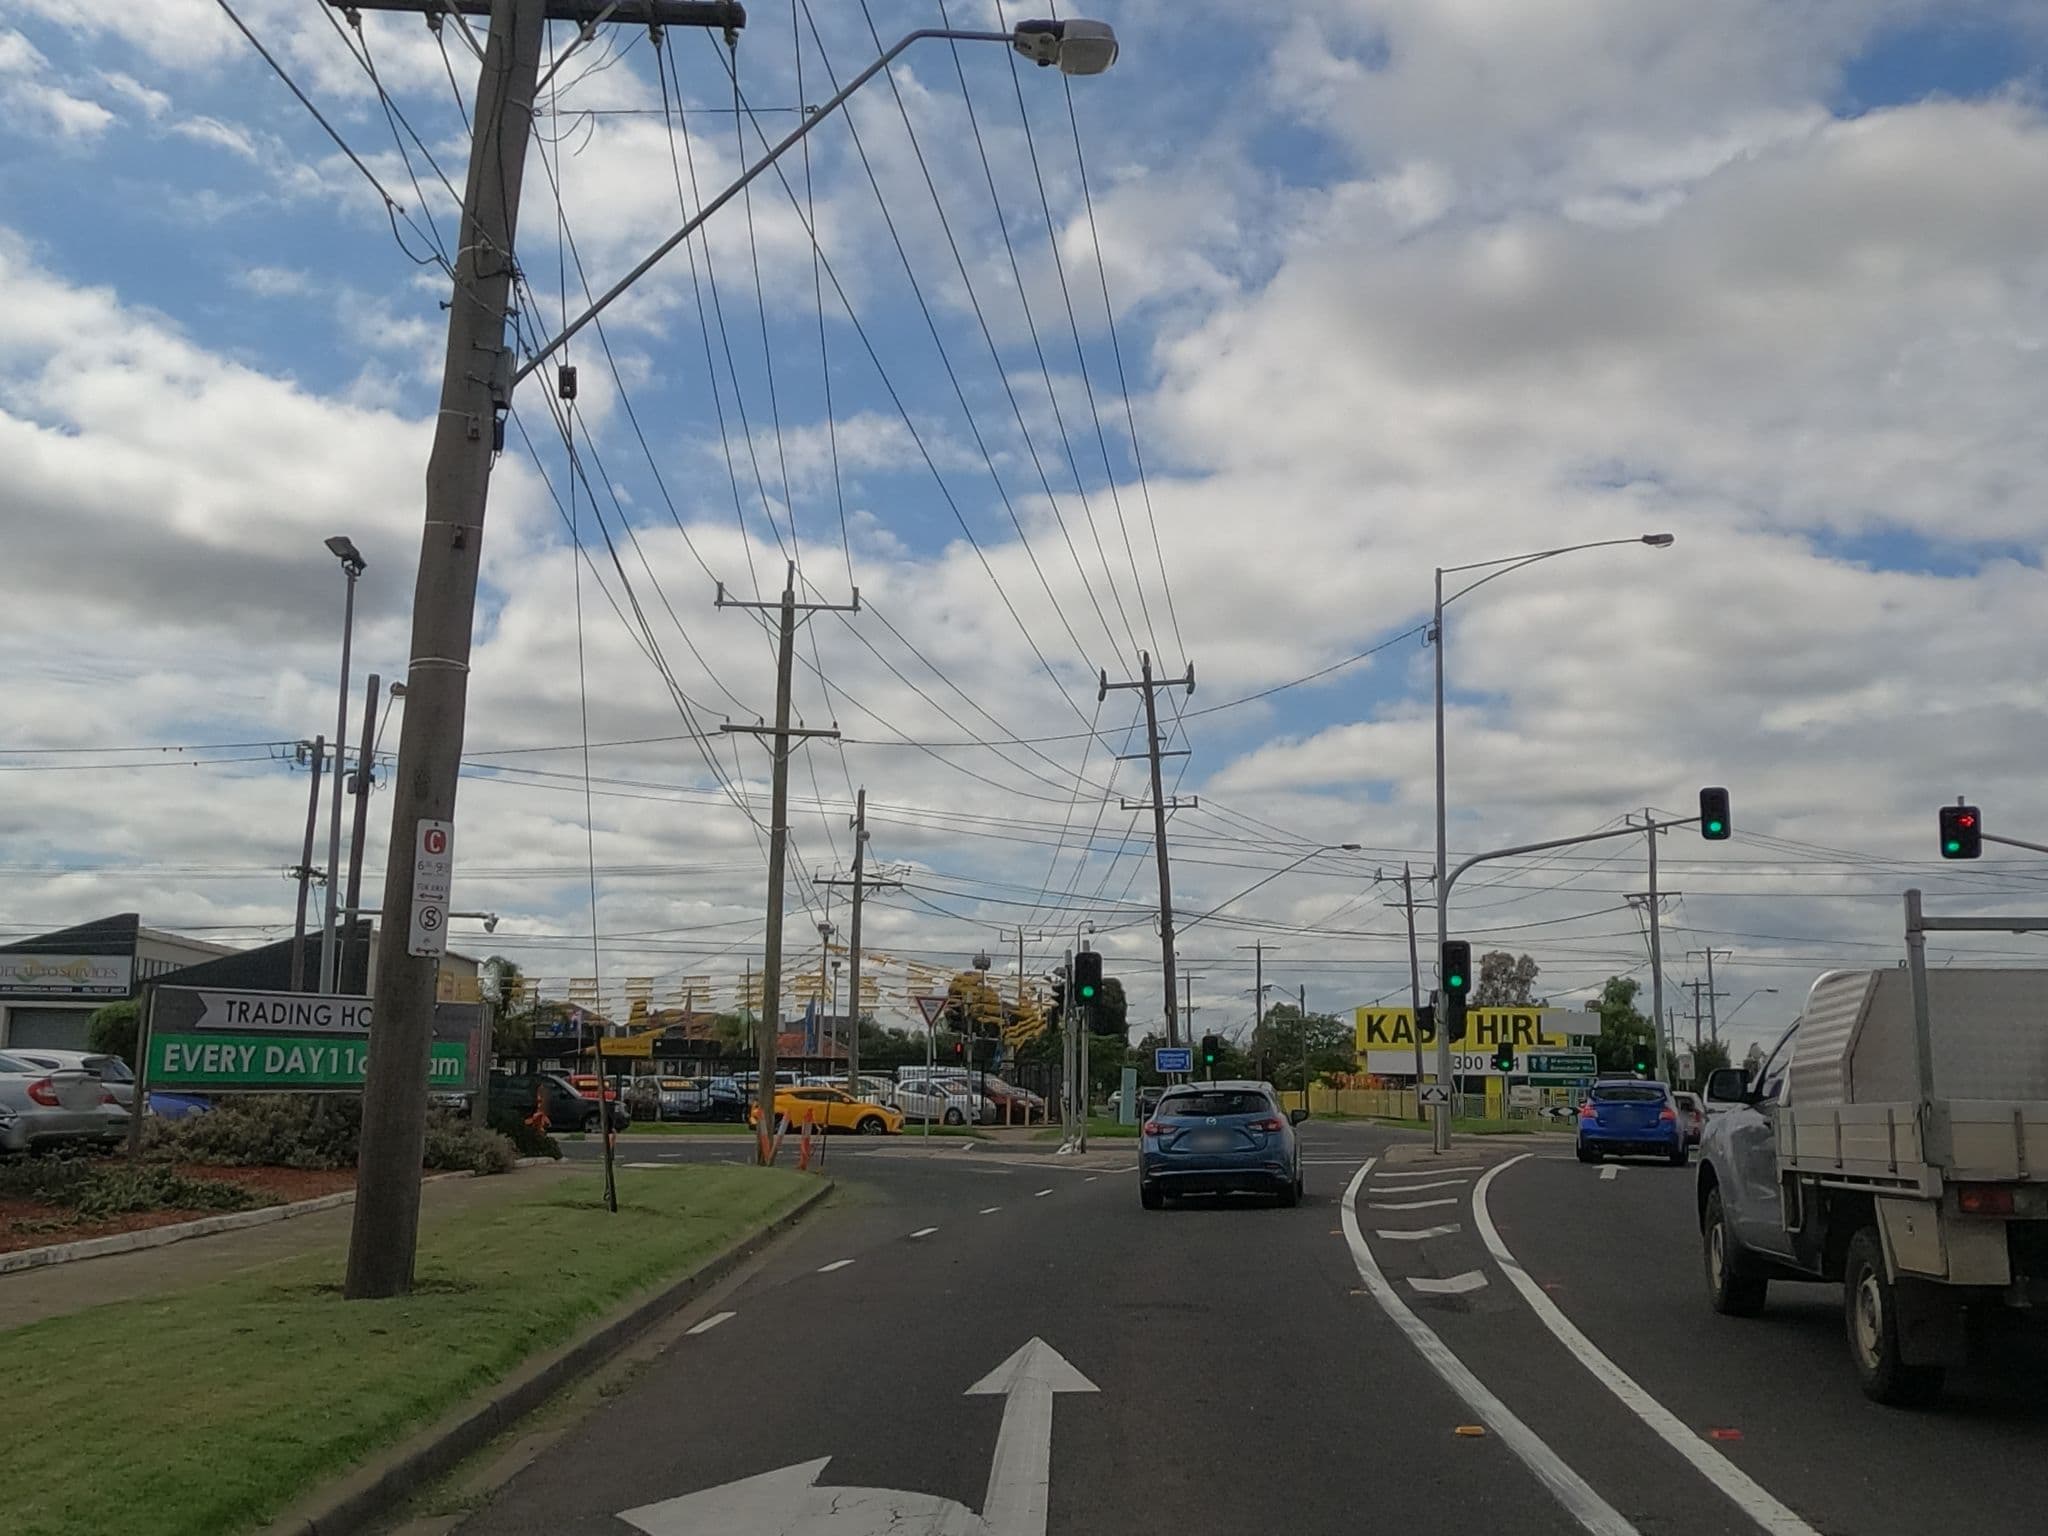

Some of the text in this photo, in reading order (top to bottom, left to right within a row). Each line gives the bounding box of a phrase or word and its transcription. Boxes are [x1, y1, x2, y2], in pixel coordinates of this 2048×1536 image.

[429, 831, 441, 853] C
[226, 1000, 373, 1028] TRADING HO
[1366, 1014, 1459, 1044] KA
[163, 1043, 256, 1072] EVERY
